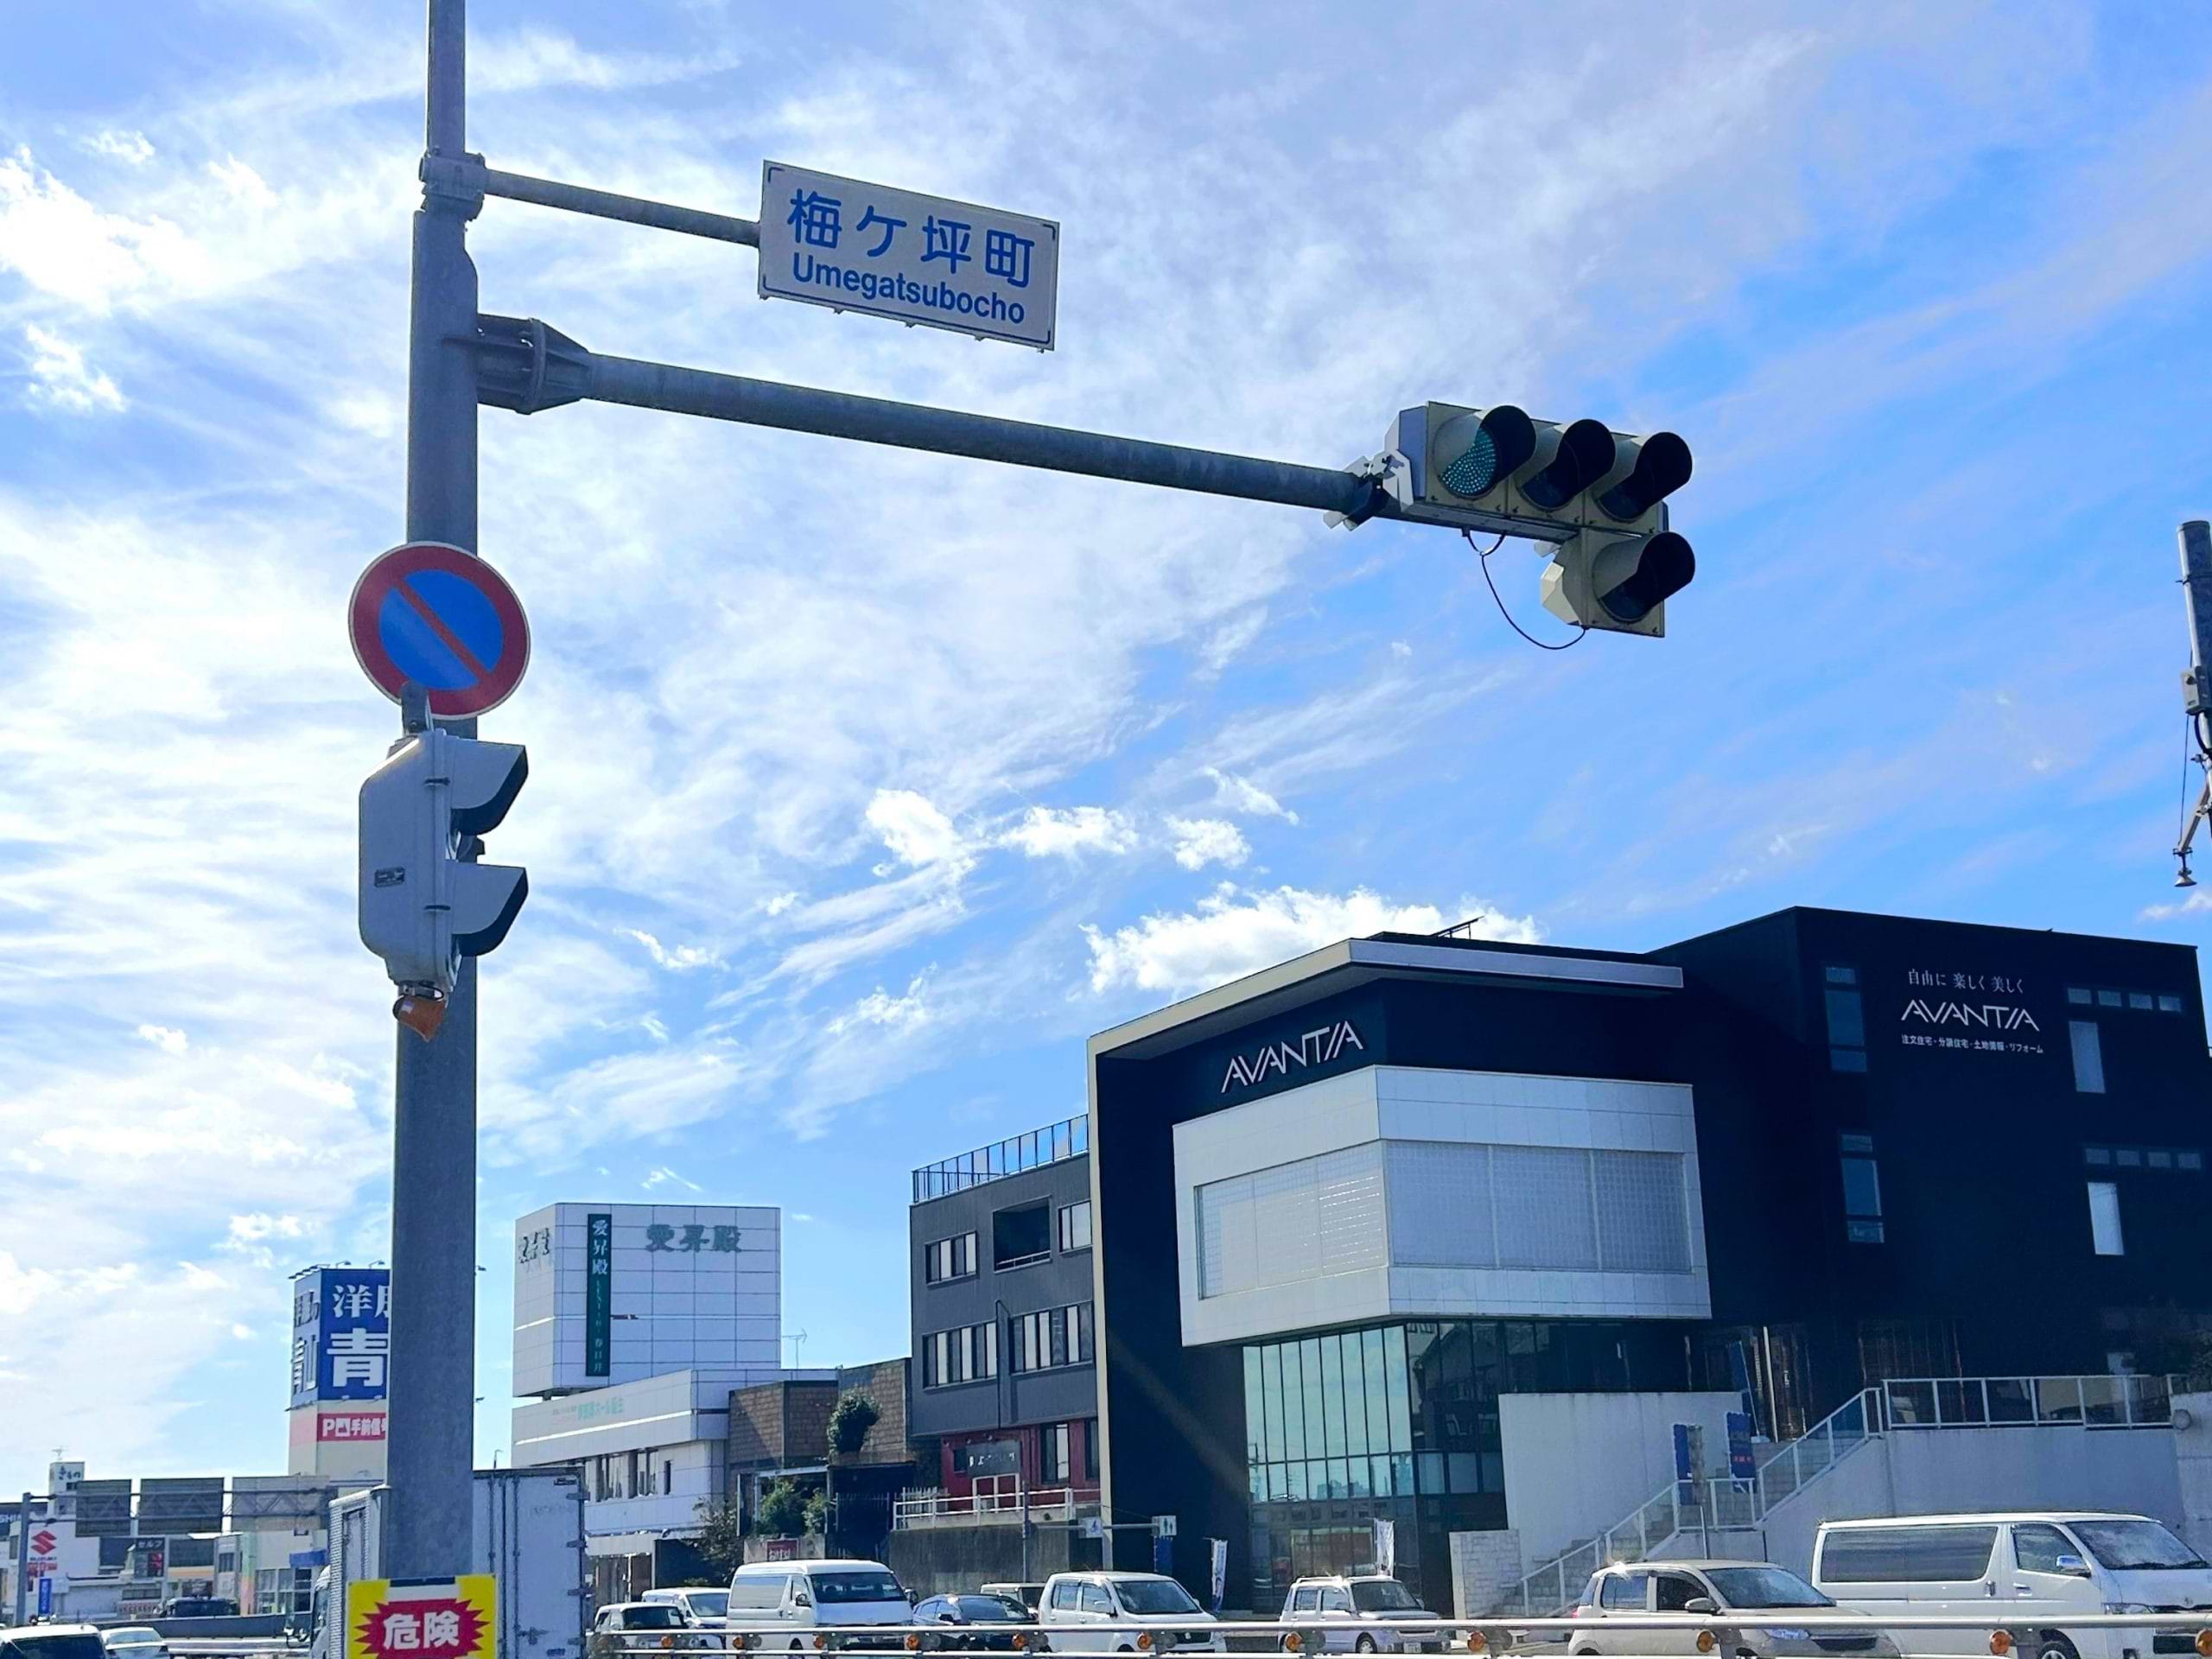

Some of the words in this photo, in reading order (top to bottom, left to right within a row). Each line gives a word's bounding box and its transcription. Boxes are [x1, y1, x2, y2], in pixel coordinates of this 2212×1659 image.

[793, 251, 1025, 324] Umegatsubocho
[1908, 969, 1946, 987] 自由に
[1953, 972, 1986, 990] 楽しく
[1991, 976, 2024, 994] 美しく
[1901, 999, 2040, 1032] AVANTIA
[1220, 1020, 1364, 1093] AVANTIA
[383, 1610, 461, 1650] 危険
